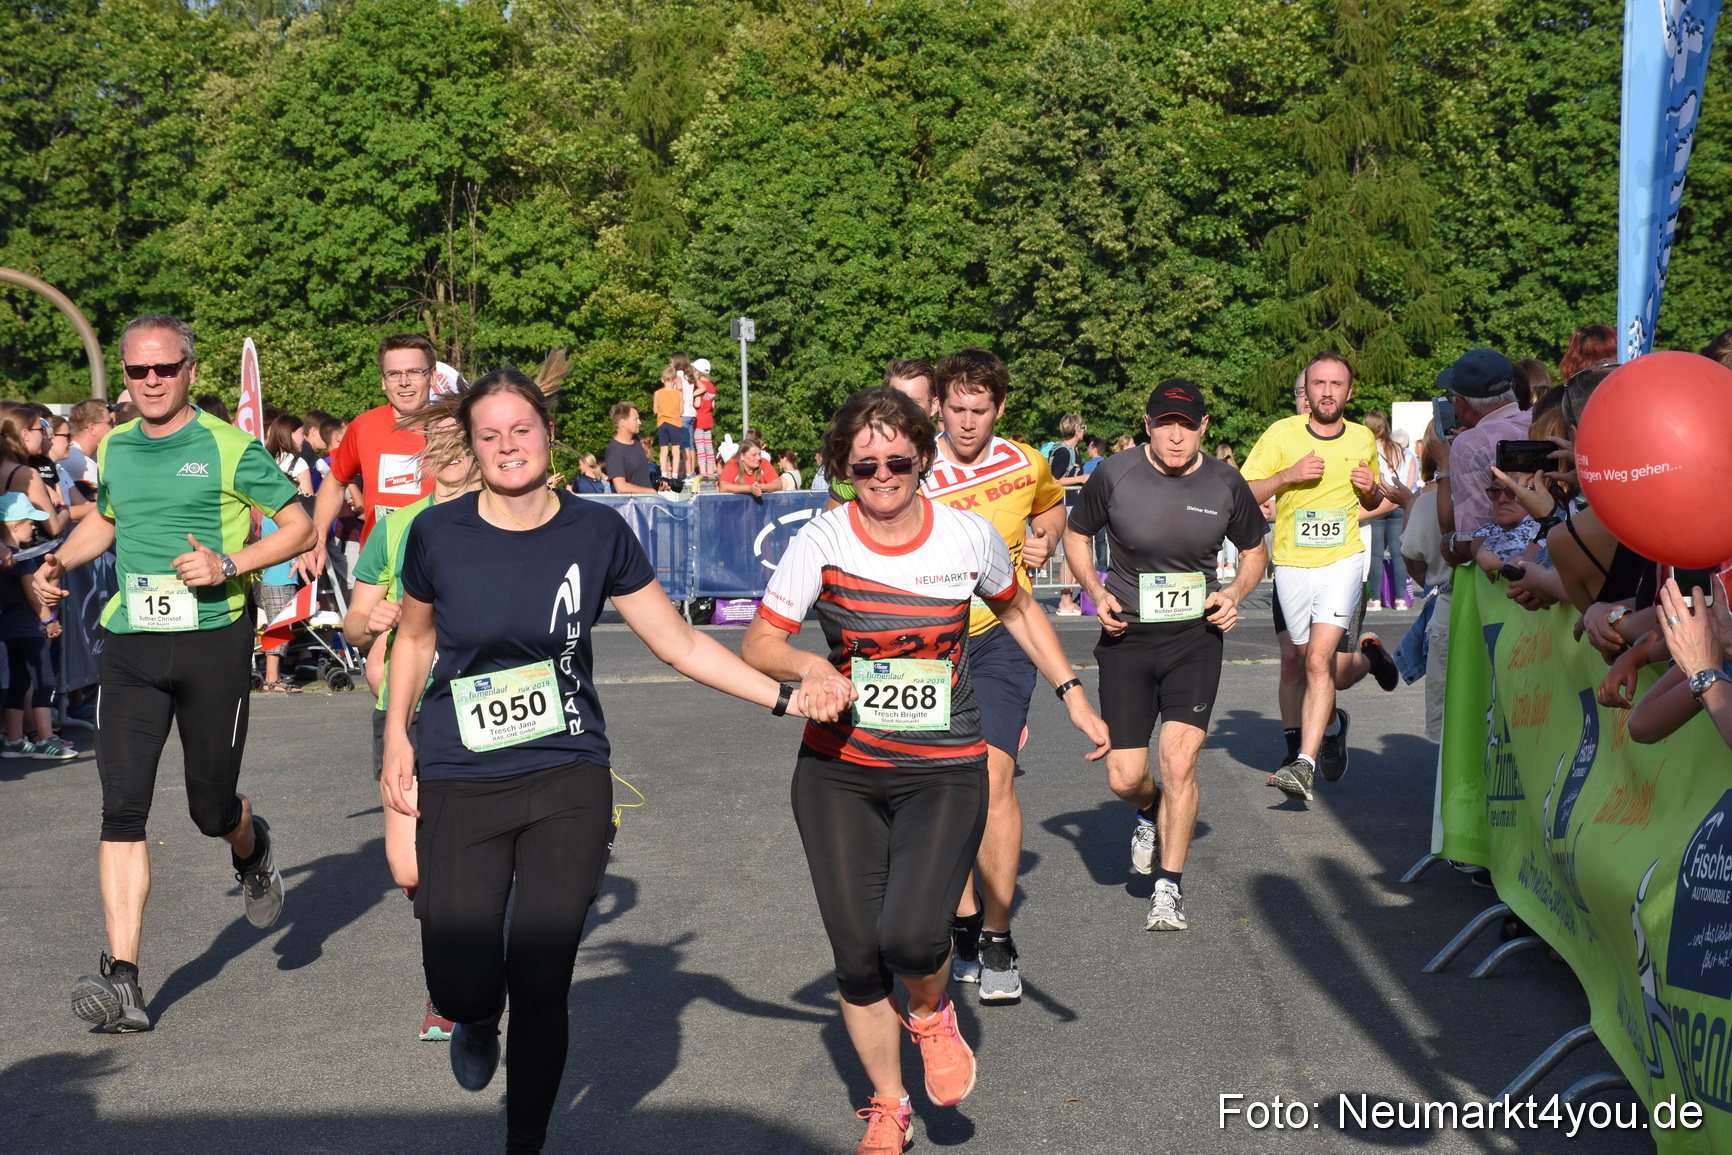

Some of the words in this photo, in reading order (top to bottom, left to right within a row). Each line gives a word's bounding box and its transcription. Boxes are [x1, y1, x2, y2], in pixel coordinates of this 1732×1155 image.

[1575, 453, 1589, 466] EHN
[178, 462, 209, 475] AOK
[1603, 469, 1628, 483] Weg
[1630, 462, 1682, 481] gehen...
[392, 476, 407, 485] DEHN
[949, 494, 981, 511] AX
[984, 474, 1037, 503] BÖGL
[1186, 505, 1204, 513] Dietmar
[1301, 522, 1341, 537] 2195
[915, 571, 968, 585] NEUMARKT
[145, 595, 171, 616] 15
[1155, 590, 1190, 609] 171
[866, 671, 905, 680] firmenlauf
[469, 685, 508, 700] firmenlauf
[532, 680, 551, 691] 2019
[863, 683, 937, 710] 2268
[470, 690, 547, 730] 1950
[873, 710, 899, 718] Tresch
[900, 710, 928, 720] Brigitte
[490, 723, 517, 737] Tresch
[517, 720, 537, 732] Jana
[1690, 843, 1732, 882] Fische
[1691, 886, 1731, 904] AUTOMOBILE
